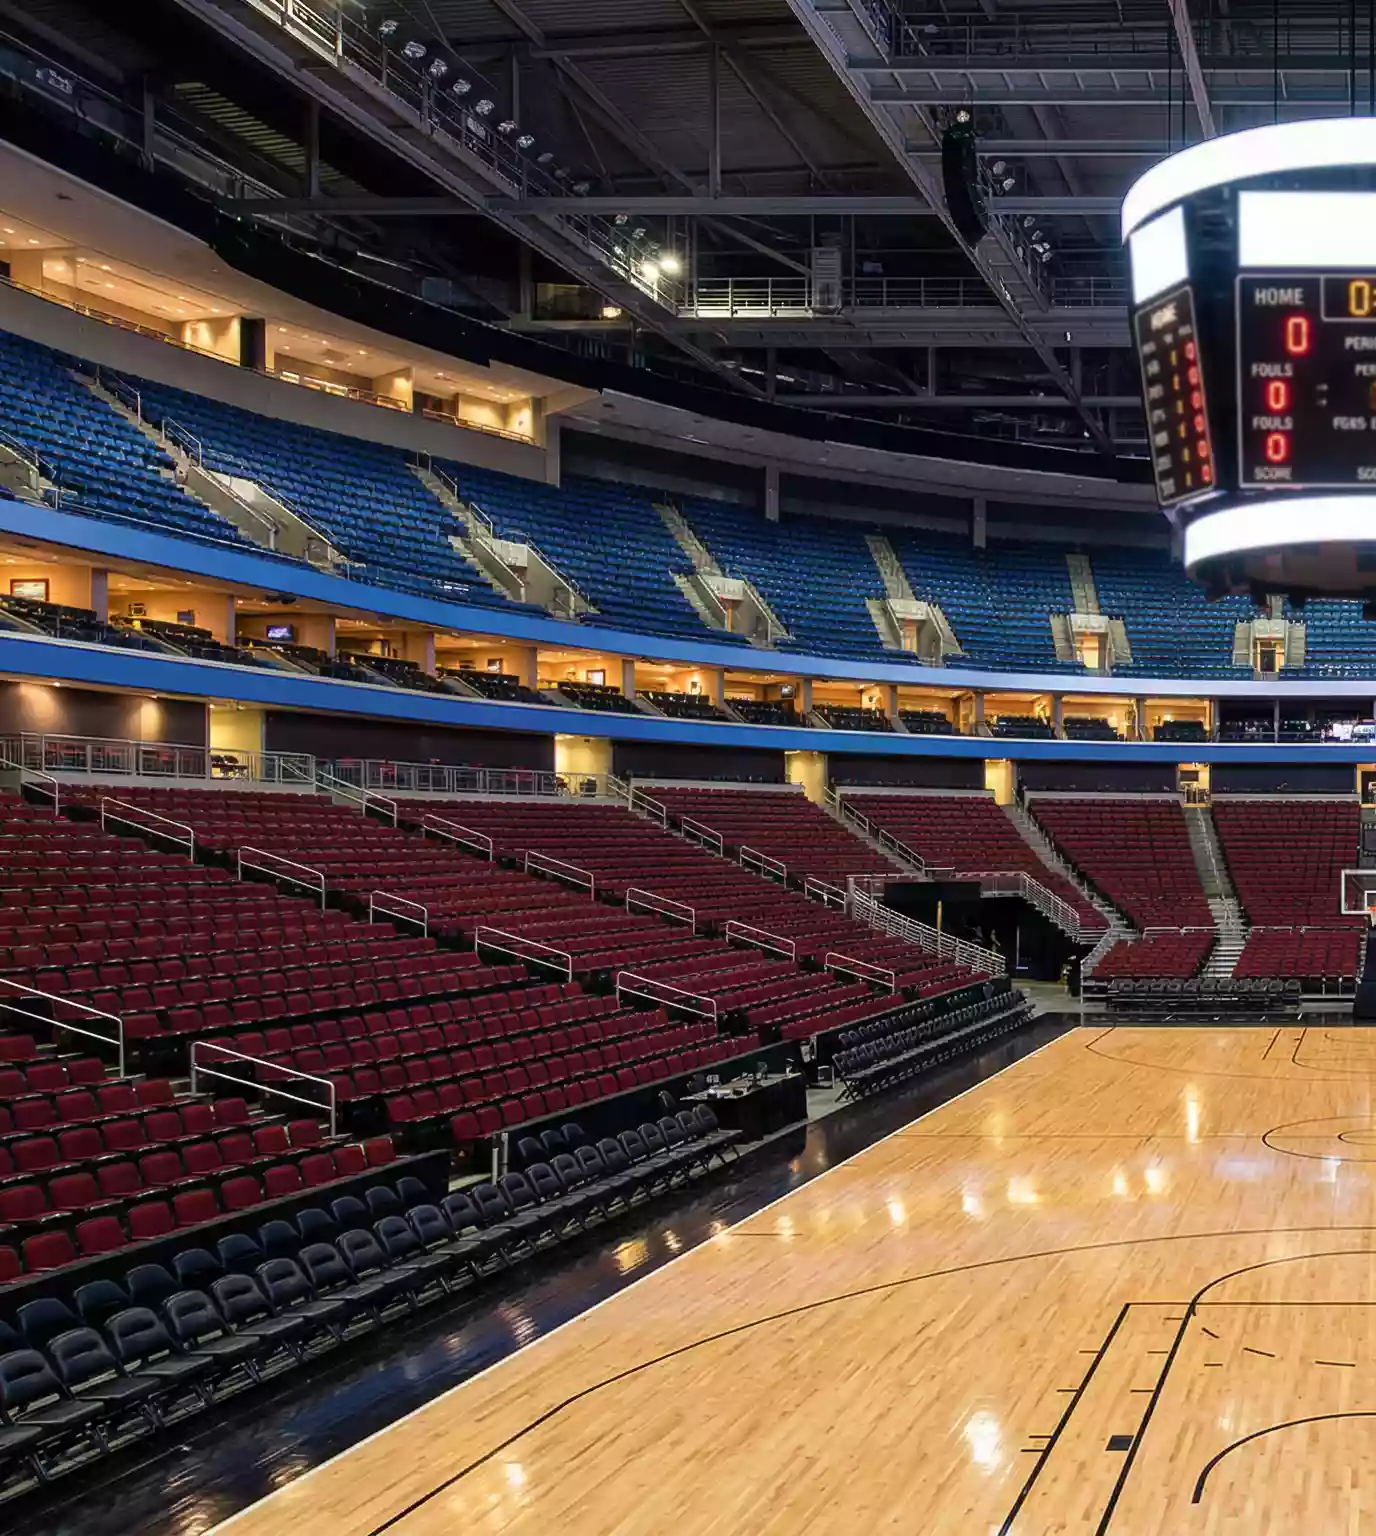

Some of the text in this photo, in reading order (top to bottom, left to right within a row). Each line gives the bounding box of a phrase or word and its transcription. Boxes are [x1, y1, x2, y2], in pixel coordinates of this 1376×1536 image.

[1254, 287, 1304, 305] HOME
[1286, 316, 1309, 353] 0
[1251, 363, 1293, 377] FOULS
[1268, 381, 1286, 410] 0
[1252, 416, 1293, 430] FOULS
[1267, 433, 1286, 461] 0
